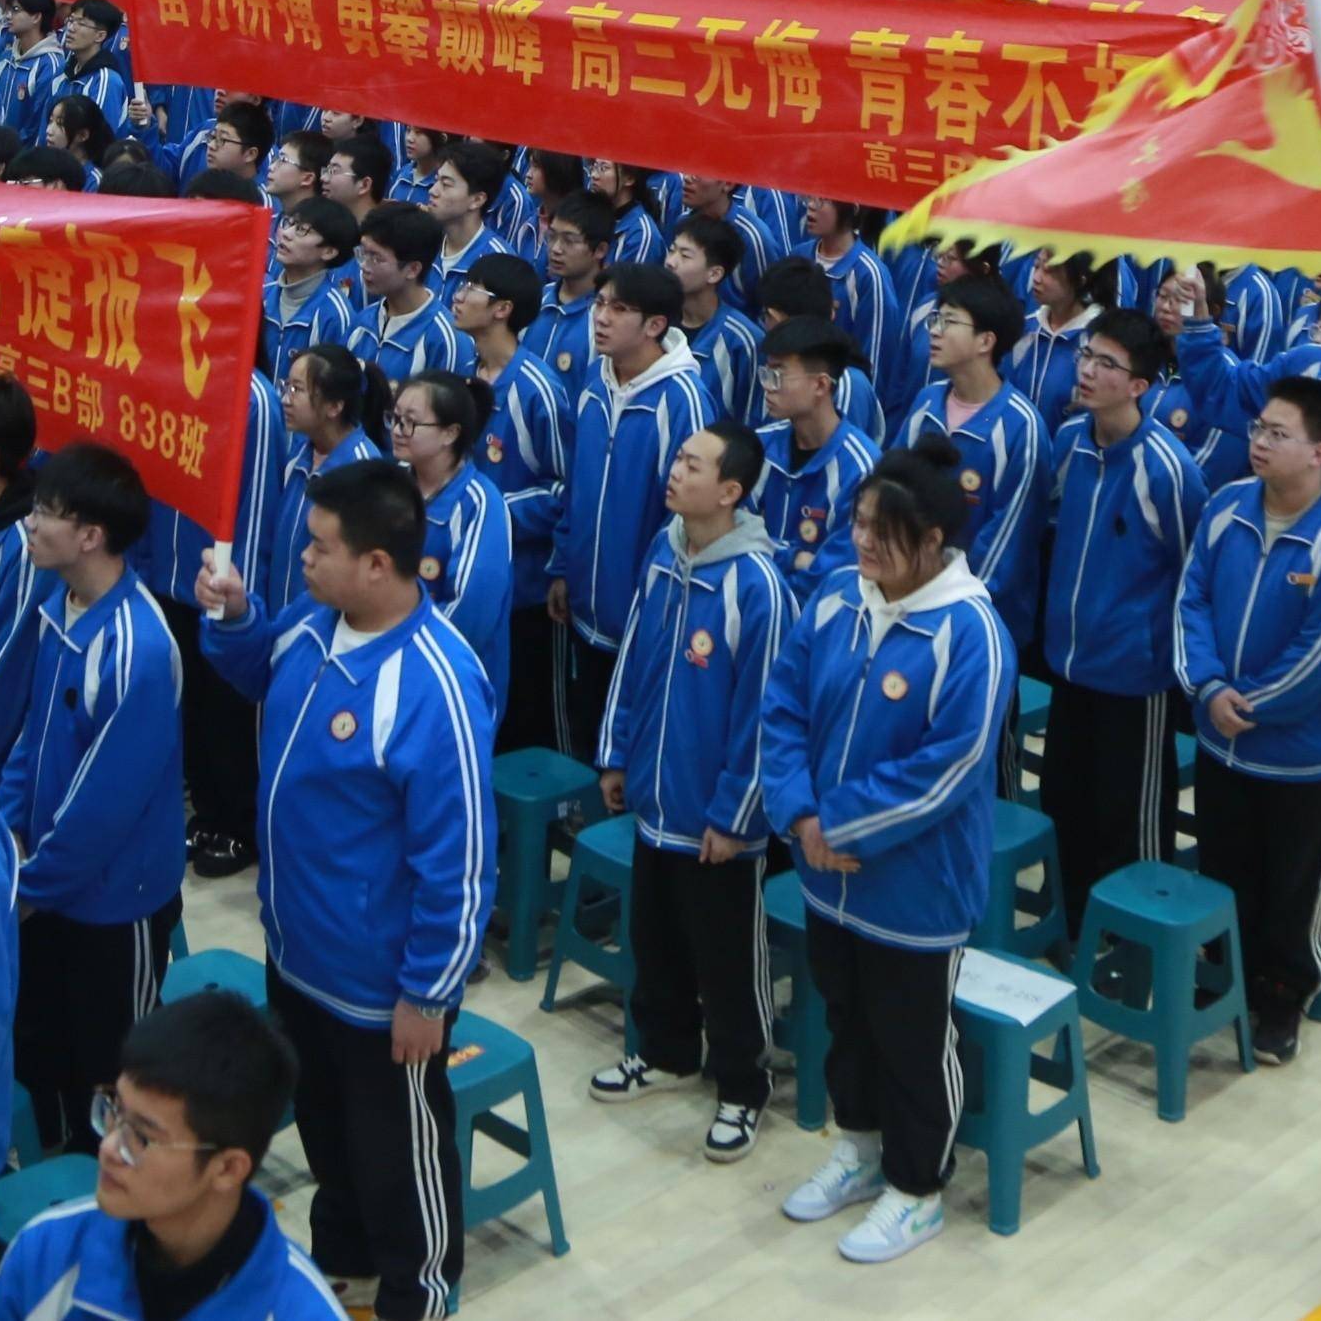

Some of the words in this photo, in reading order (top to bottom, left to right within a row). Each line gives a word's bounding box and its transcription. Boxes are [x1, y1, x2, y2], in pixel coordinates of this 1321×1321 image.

[565, 1, 822, 124] 高三无悔
[118, 394, 210, 480] 838班
